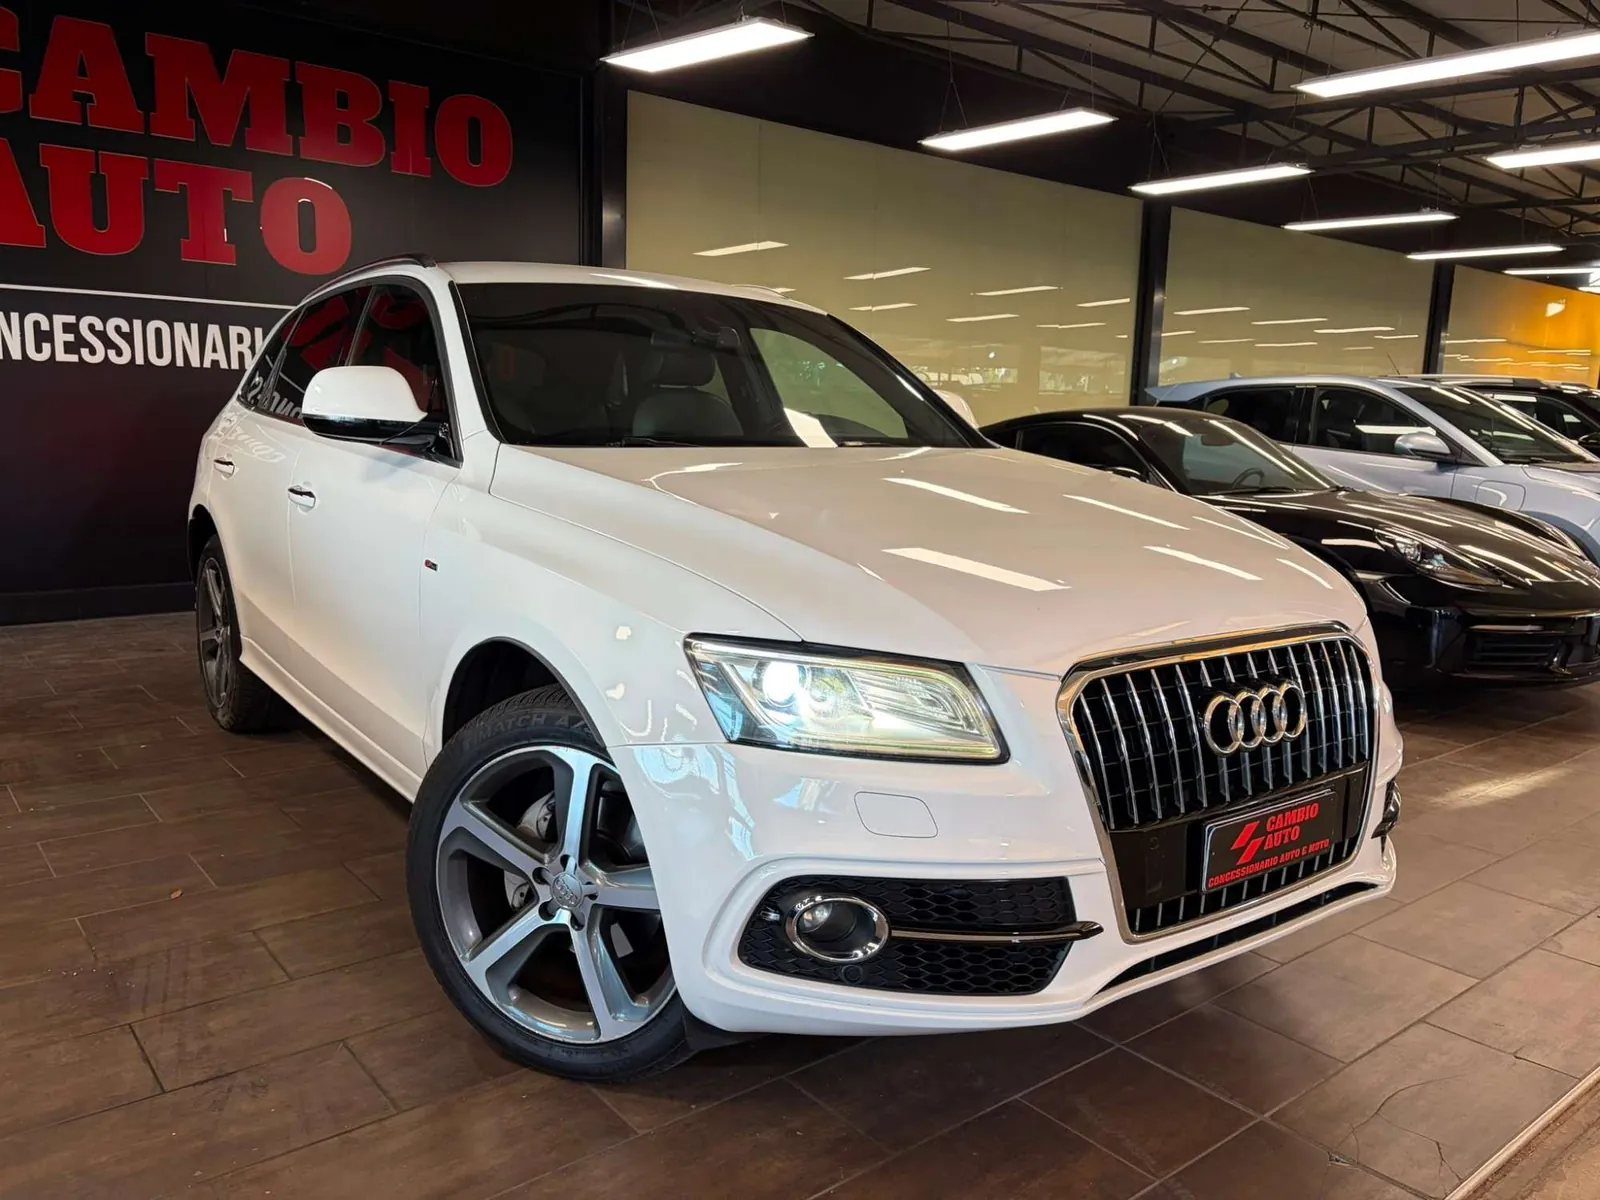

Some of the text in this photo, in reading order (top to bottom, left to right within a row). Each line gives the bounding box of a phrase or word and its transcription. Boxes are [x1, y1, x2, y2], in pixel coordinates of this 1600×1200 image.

[1266, 802, 1320, 832] CAMBIO
[1264, 826, 1301, 850] AUTO
[1208, 838, 1330, 888] CONCESSIONARIO AUTO E MOTO
